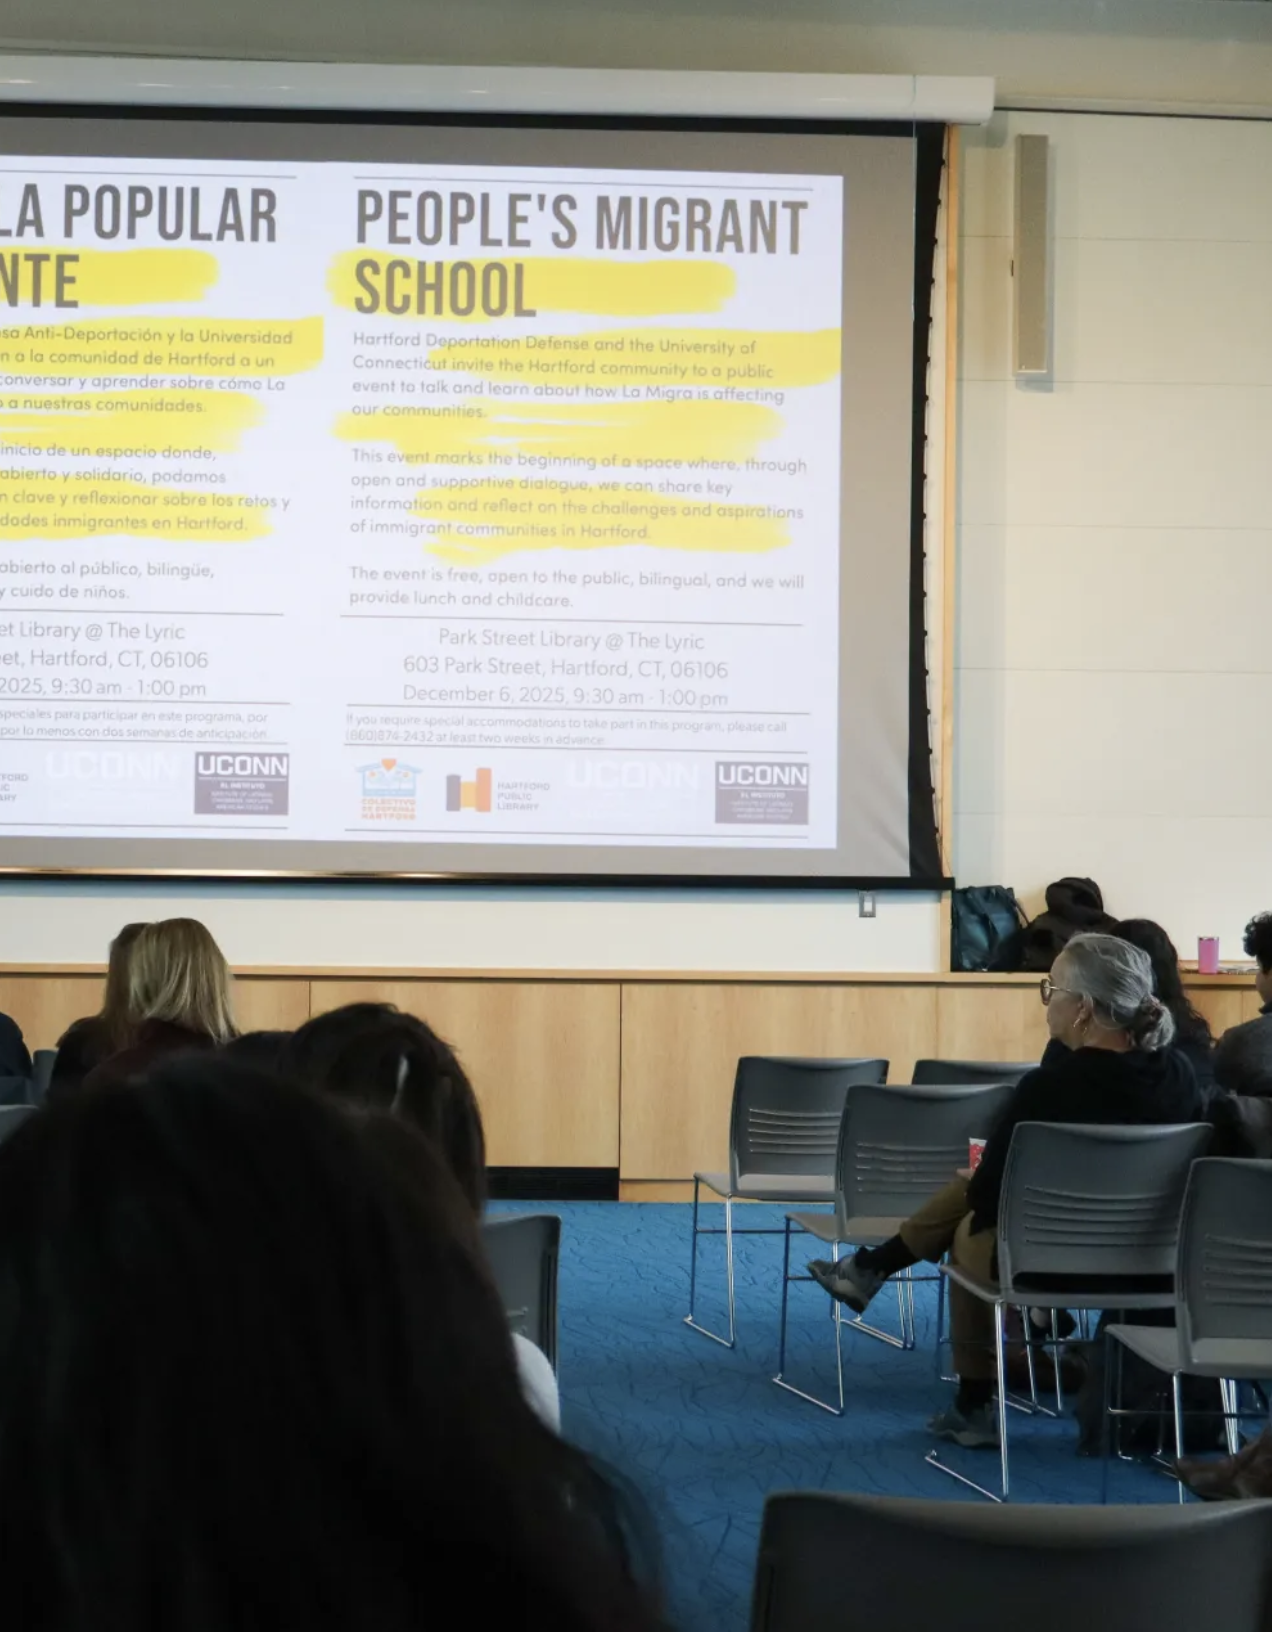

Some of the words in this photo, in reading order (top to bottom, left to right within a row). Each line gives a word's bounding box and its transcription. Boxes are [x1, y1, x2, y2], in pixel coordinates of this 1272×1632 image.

[64, 183, 276, 243] POPULAR
[357, 189, 577, 250] PEOPLE'S
[596, 195, 808, 255] MIGRANT
[355, 258, 537, 318] SCHOOL
[24, 325, 162, 344] Anti-Deportación
[167, 332, 175, 346] y
[180, 328, 194, 343] la
[199, 329, 293, 344] Universidad
[354, 331, 421, 347] Hartford
[426, 332, 520, 352] Deportation
[526, 335, 589, 351] Defense
[594, 337, 624, 353] and
[629, 337, 654, 353] the
[659, 338, 735, 358] University
[740, 339, 756, 355] of
[15, 351, 25, 363] a
[30, 348, 44, 364] la
[49, 350, 139, 365] comunidad
[143, 349, 163, 366] de
[168, 351, 235, 367] Hartford
[240, 356, 250, 367] a
[255, 356, 274, 368] un
[353, 354, 447, 371] Connecticut
[451, 357, 494, 374] invite
[499, 357, 524, 373] the
[528, 358, 595, 375] Hartford
[600, 363, 688, 380] community
[692, 363, 708, 377] to
[711, 366, 722, 378] a
[727, 362, 773, 382] public
[79, 377, 87, 390] y
[91, 372, 167, 392] aprender
[170, 374, 214, 391] sobre
[218, 376, 262, 391] cómo
[267, 376, 285, 391] La
[352, 379, 395, 393] event
[400, 379, 415, 394] to
[420, 378, 449, 394] talk
[452, 379, 483, 396] and
[488, 380, 529, 396] learn
[533, 381, 580, 398] about
[585, 383, 618, 399] how
[622, 384, 641, 399] La
[645, 384, 693, 404] Migra
[697, 385, 709, 401] is
[713, 385, 785, 407] affecting
[8, 398, 18, 410] a
[23, 397, 91, 413] nuestras
[96, 397, 206, 413] comunidades.
[352, 404, 379, 416] our
[382, 403, 487, 419] communities.
[11, 583, 54, 599] cuido
[59, 583, 79, 599] de
[84, 585, 129, 599] niños.
[350, 589, 410, 607] provide
[414, 590, 456, 605] lunch
[461, 591, 493, 607] and
[496, 590, 573, 608] childcare.
[20, 621, 81, 642] Library
[85, 623, 103, 643] @
[107, 621, 140, 639] The
[145, 622, 185, 643] Lyric
[439, 628, 477, 646] Park
[482, 628, 536, 647] Street
[540, 629, 601, 652] Library
[605, 633, 624, 653] @
[627, 631, 660, 650] The
[665, 633, 704, 654] Lyric
[30, 648, 112, 670] Hartford,
[118, 650, 145, 671] CT,
[151, 650, 208, 669] 06106
[404, 654, 439, 674] 603
[445, 655, 482, 675] Park
[488, 656, 546, 678] Street,
[551, 657, 633, 680] Hartford,
[638, 660, 665, 681] CT,
[671, 660, 728, 680] 06106
[52, 677, 92, 694] 9:30
[96, 682, 122, 696] am
[138, 679, 175, 697] 1:00
[179, 683, 206, 699] pm
[404, 683, 495, 702] December
[499, 685, 514, 705] 6,
[519, 685, 569, 706] 2025,
[573, 686, 614, 704] 9:30
[618, 692, 644, 705] am
[660, 687, 697, 704] 1:00
[699, 694, 728, 711] pm
[450, 730, 476, 742] least
[478, 731, 500, 742] two
[505, 731, 541, 743] weeks
[45, 750, 181, 780] UCONN
[198, 755, 288, 776] UCONN
[569, 760, 700, 790] UCONN
[718, 765, 807, 786] UCONN
[497, 782, 550, 791] HARTFORD
[497, 802, 540, 811] LIBRARY
